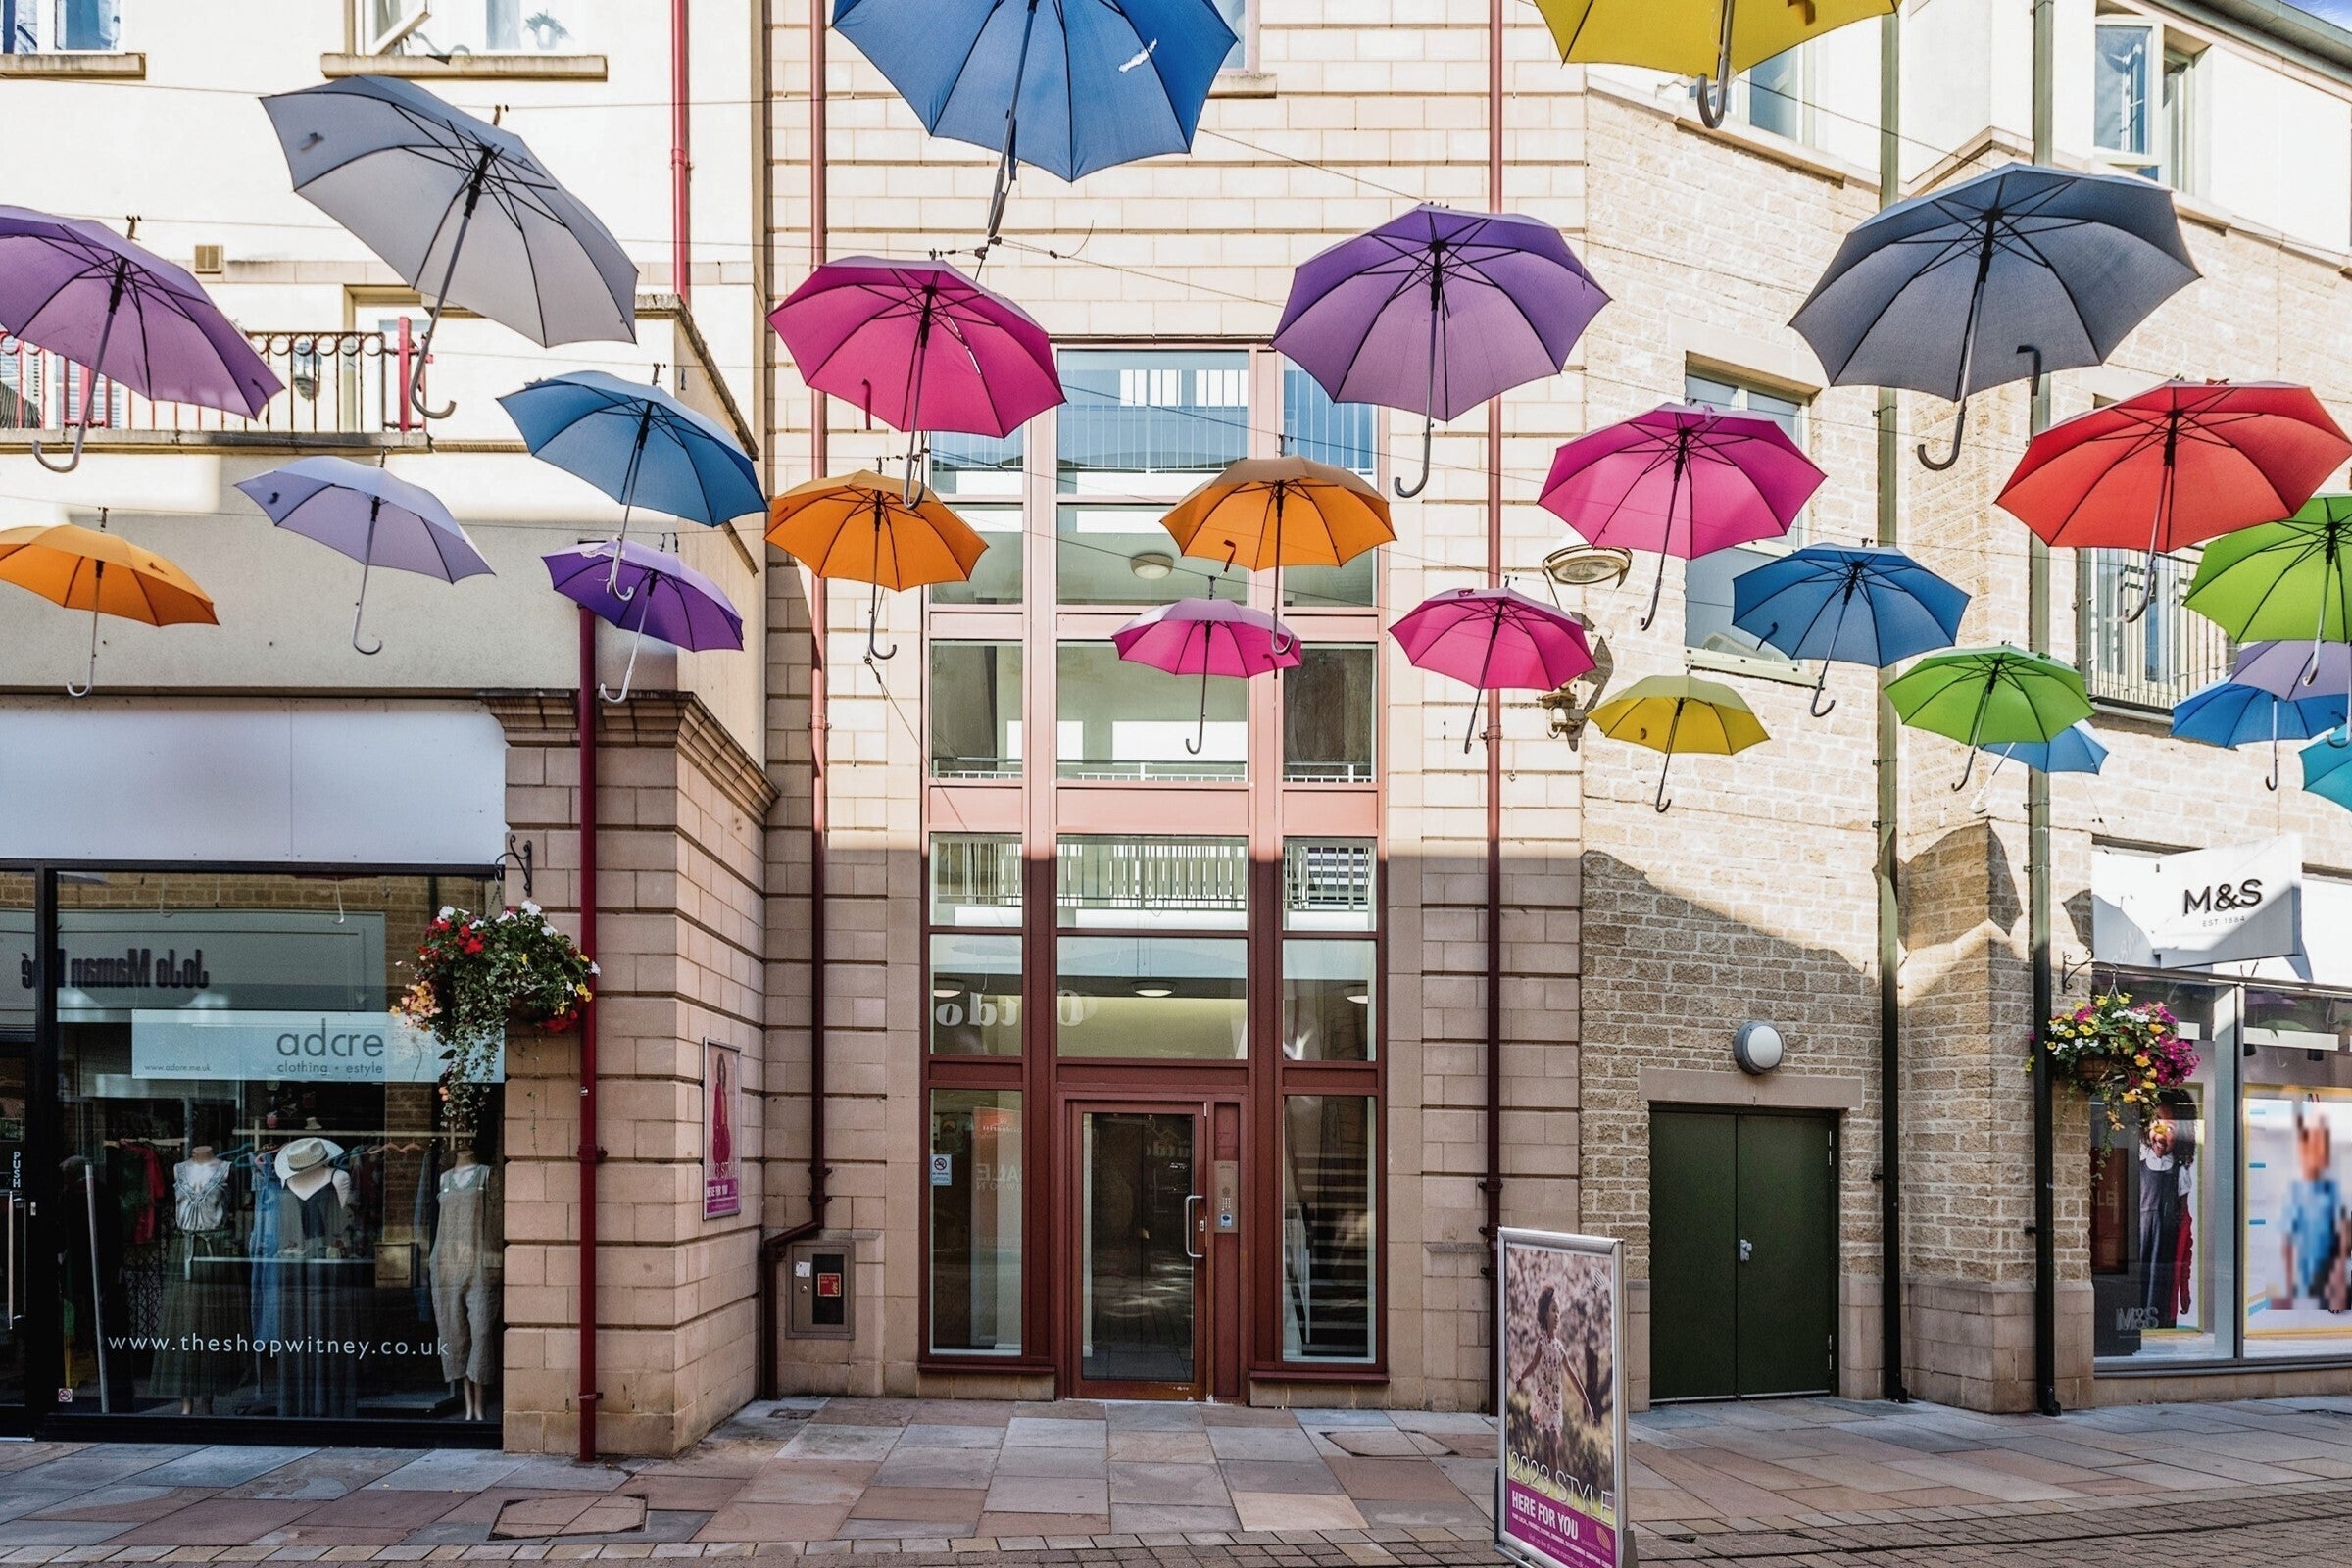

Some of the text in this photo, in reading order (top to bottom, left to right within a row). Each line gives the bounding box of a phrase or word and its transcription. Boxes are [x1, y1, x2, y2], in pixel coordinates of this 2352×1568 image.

[2182, 878, 2264, 917] M&S
[2202, 918, 2219, 928] EST
[277, 1060, 328, 1077] clothing
[2115, 1306, 2160, 1331] M&S
[108, 1332, 450, 1360] www.theshopwitney.co.uk
[1510, 1451, 1613, 1527] 2023 STYLE
[1511, 1490, 1536, 1518] HERE
[1538, 1502, 1556, 1530] FOR
[1557, 1512, 1579, 1541] YOU
